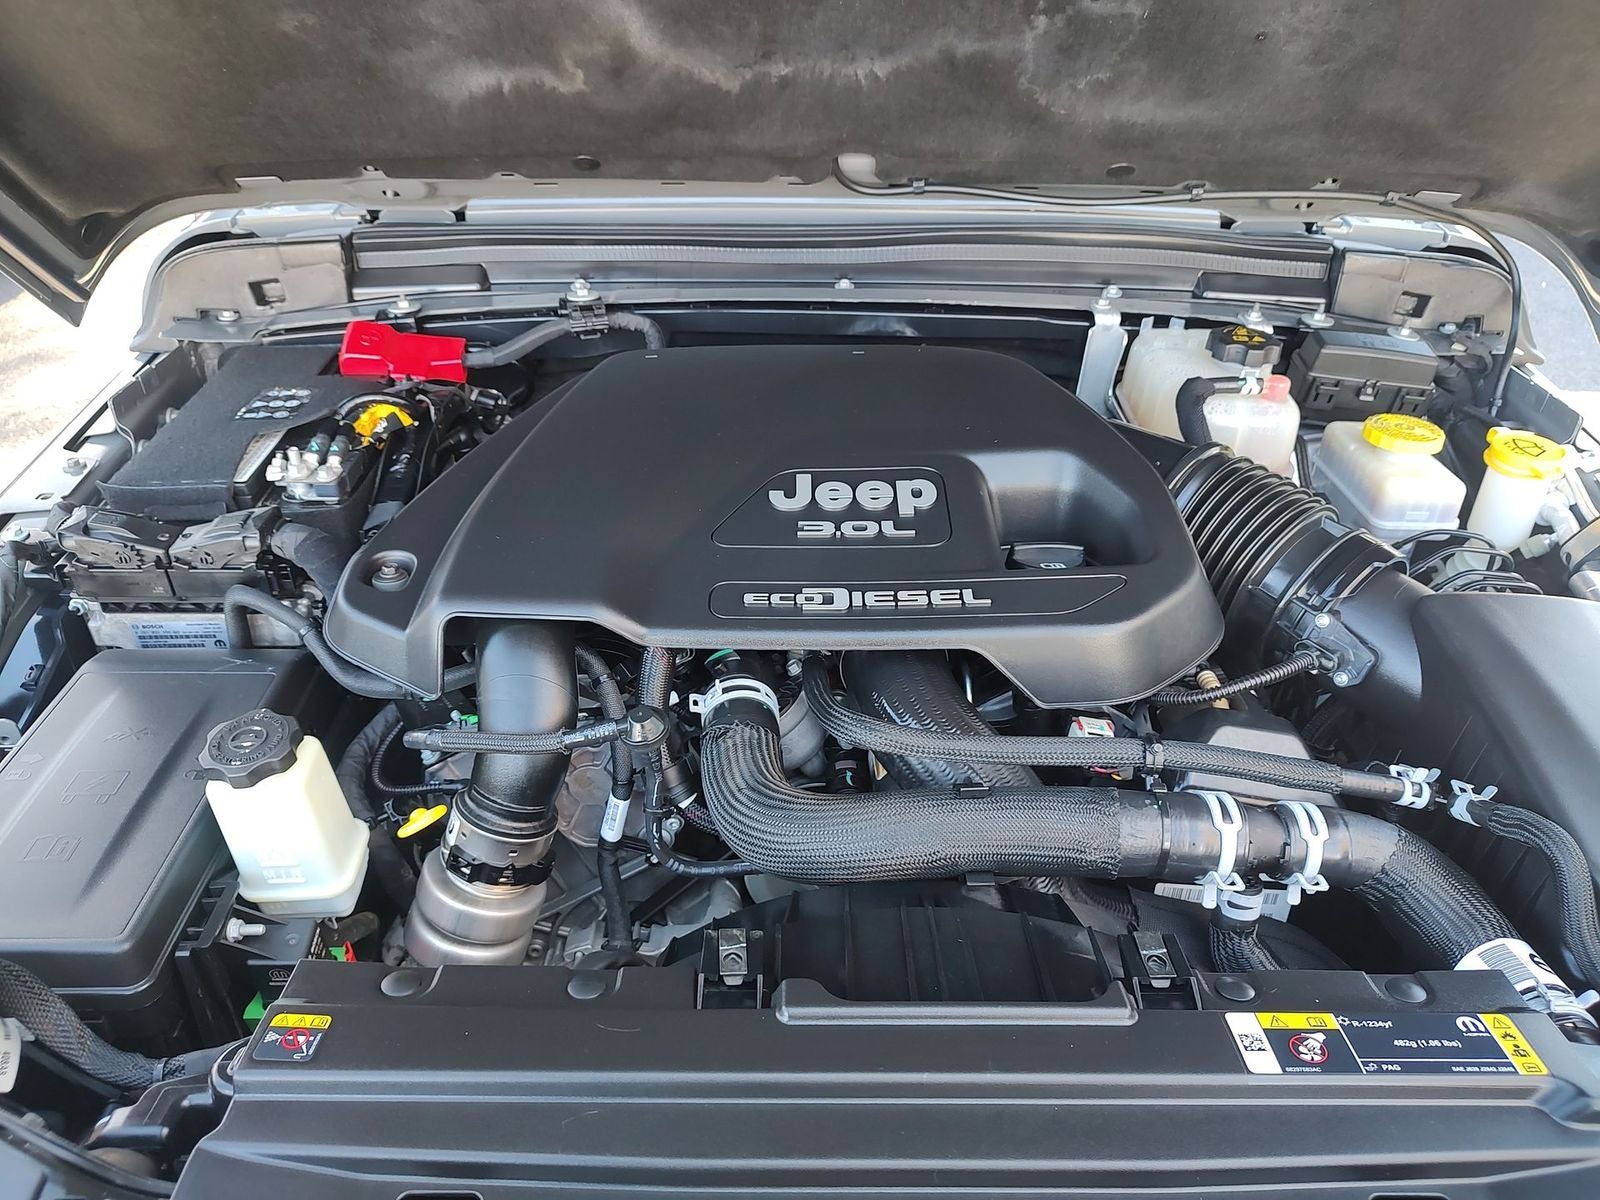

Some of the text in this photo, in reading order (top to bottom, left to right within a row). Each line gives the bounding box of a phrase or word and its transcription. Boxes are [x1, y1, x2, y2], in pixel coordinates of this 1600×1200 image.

[768, 473, 938, 517] Jeep
[797, 520, 916, 538] 3.0L
[1351, 1020, 1393, 1029] R-1234yf
[1382, 1064, 1401, 1072] PAG
